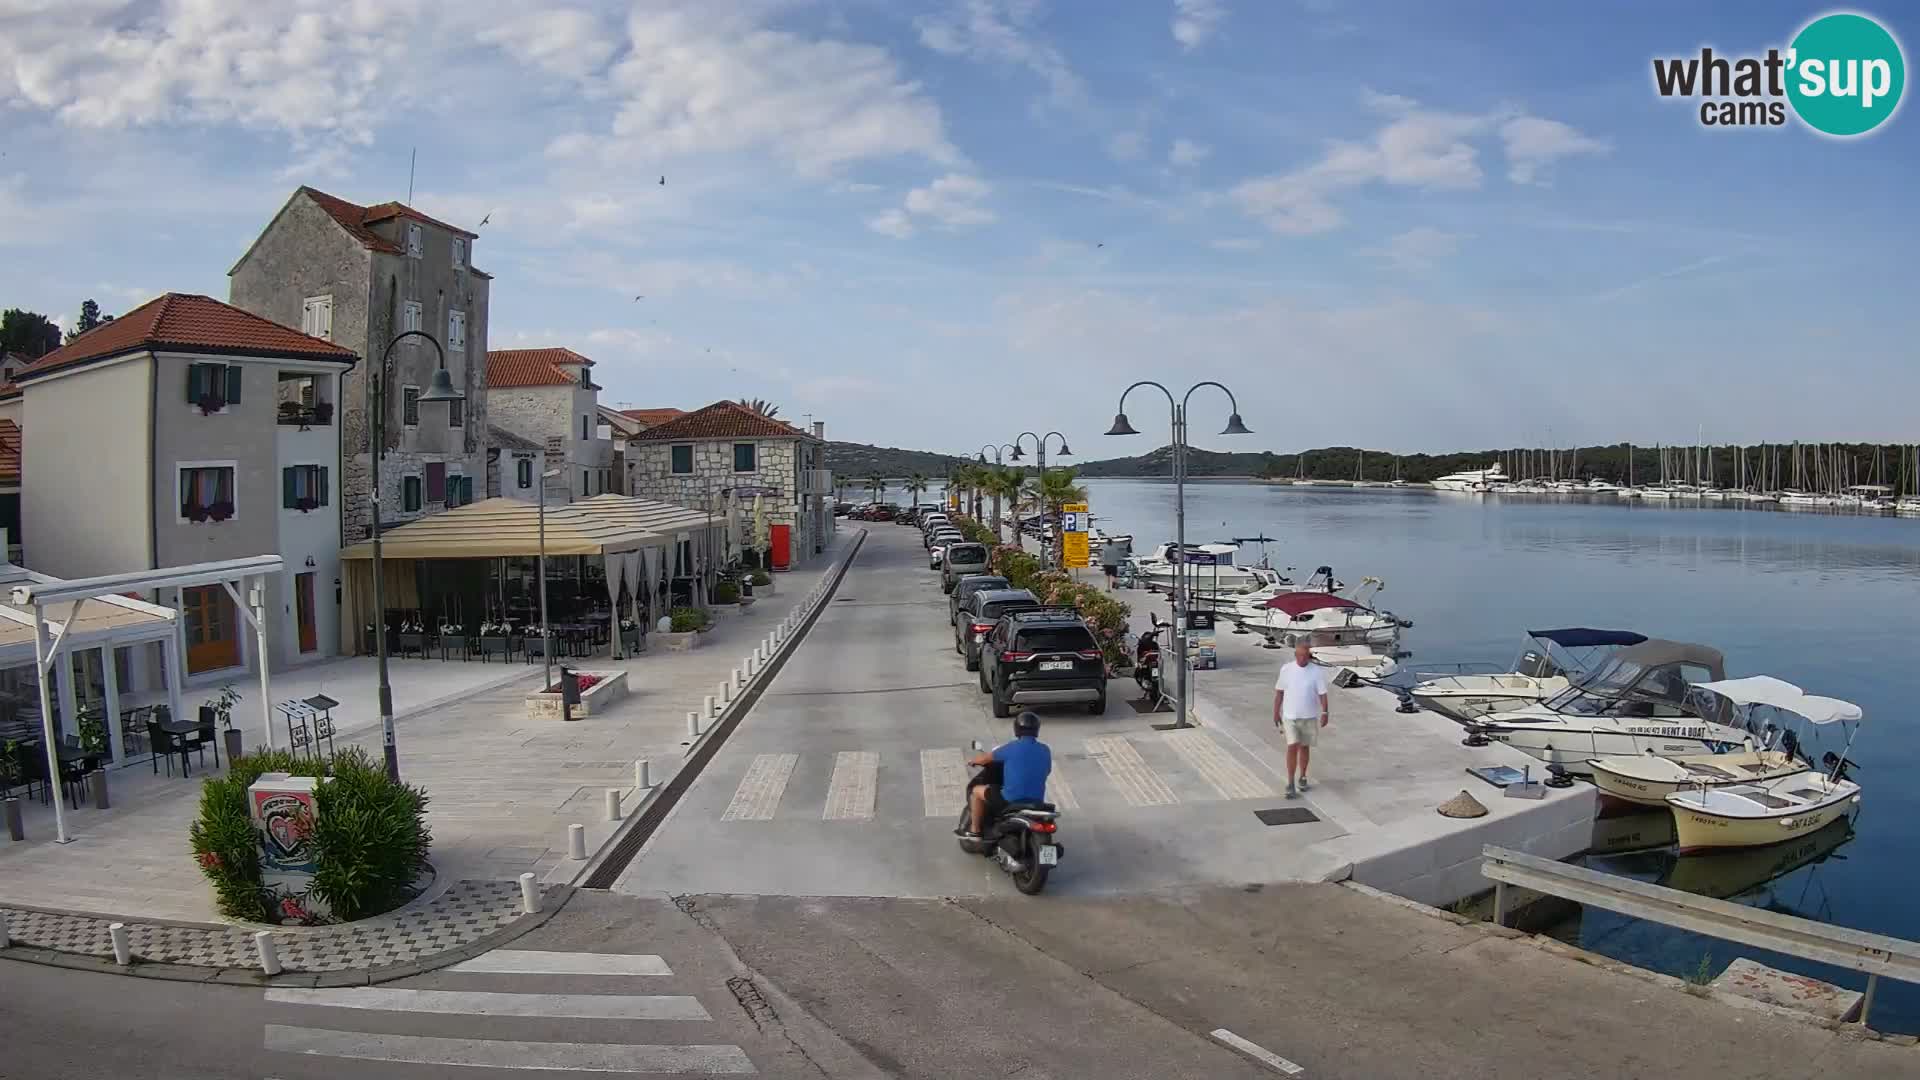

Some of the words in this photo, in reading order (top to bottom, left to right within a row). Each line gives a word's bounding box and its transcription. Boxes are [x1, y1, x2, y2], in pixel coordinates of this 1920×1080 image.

[1065, 514, 1075, 530] P
[1661, 727, 1681, 736] RENT
[1688, 727, 1706, 738] BOAT
